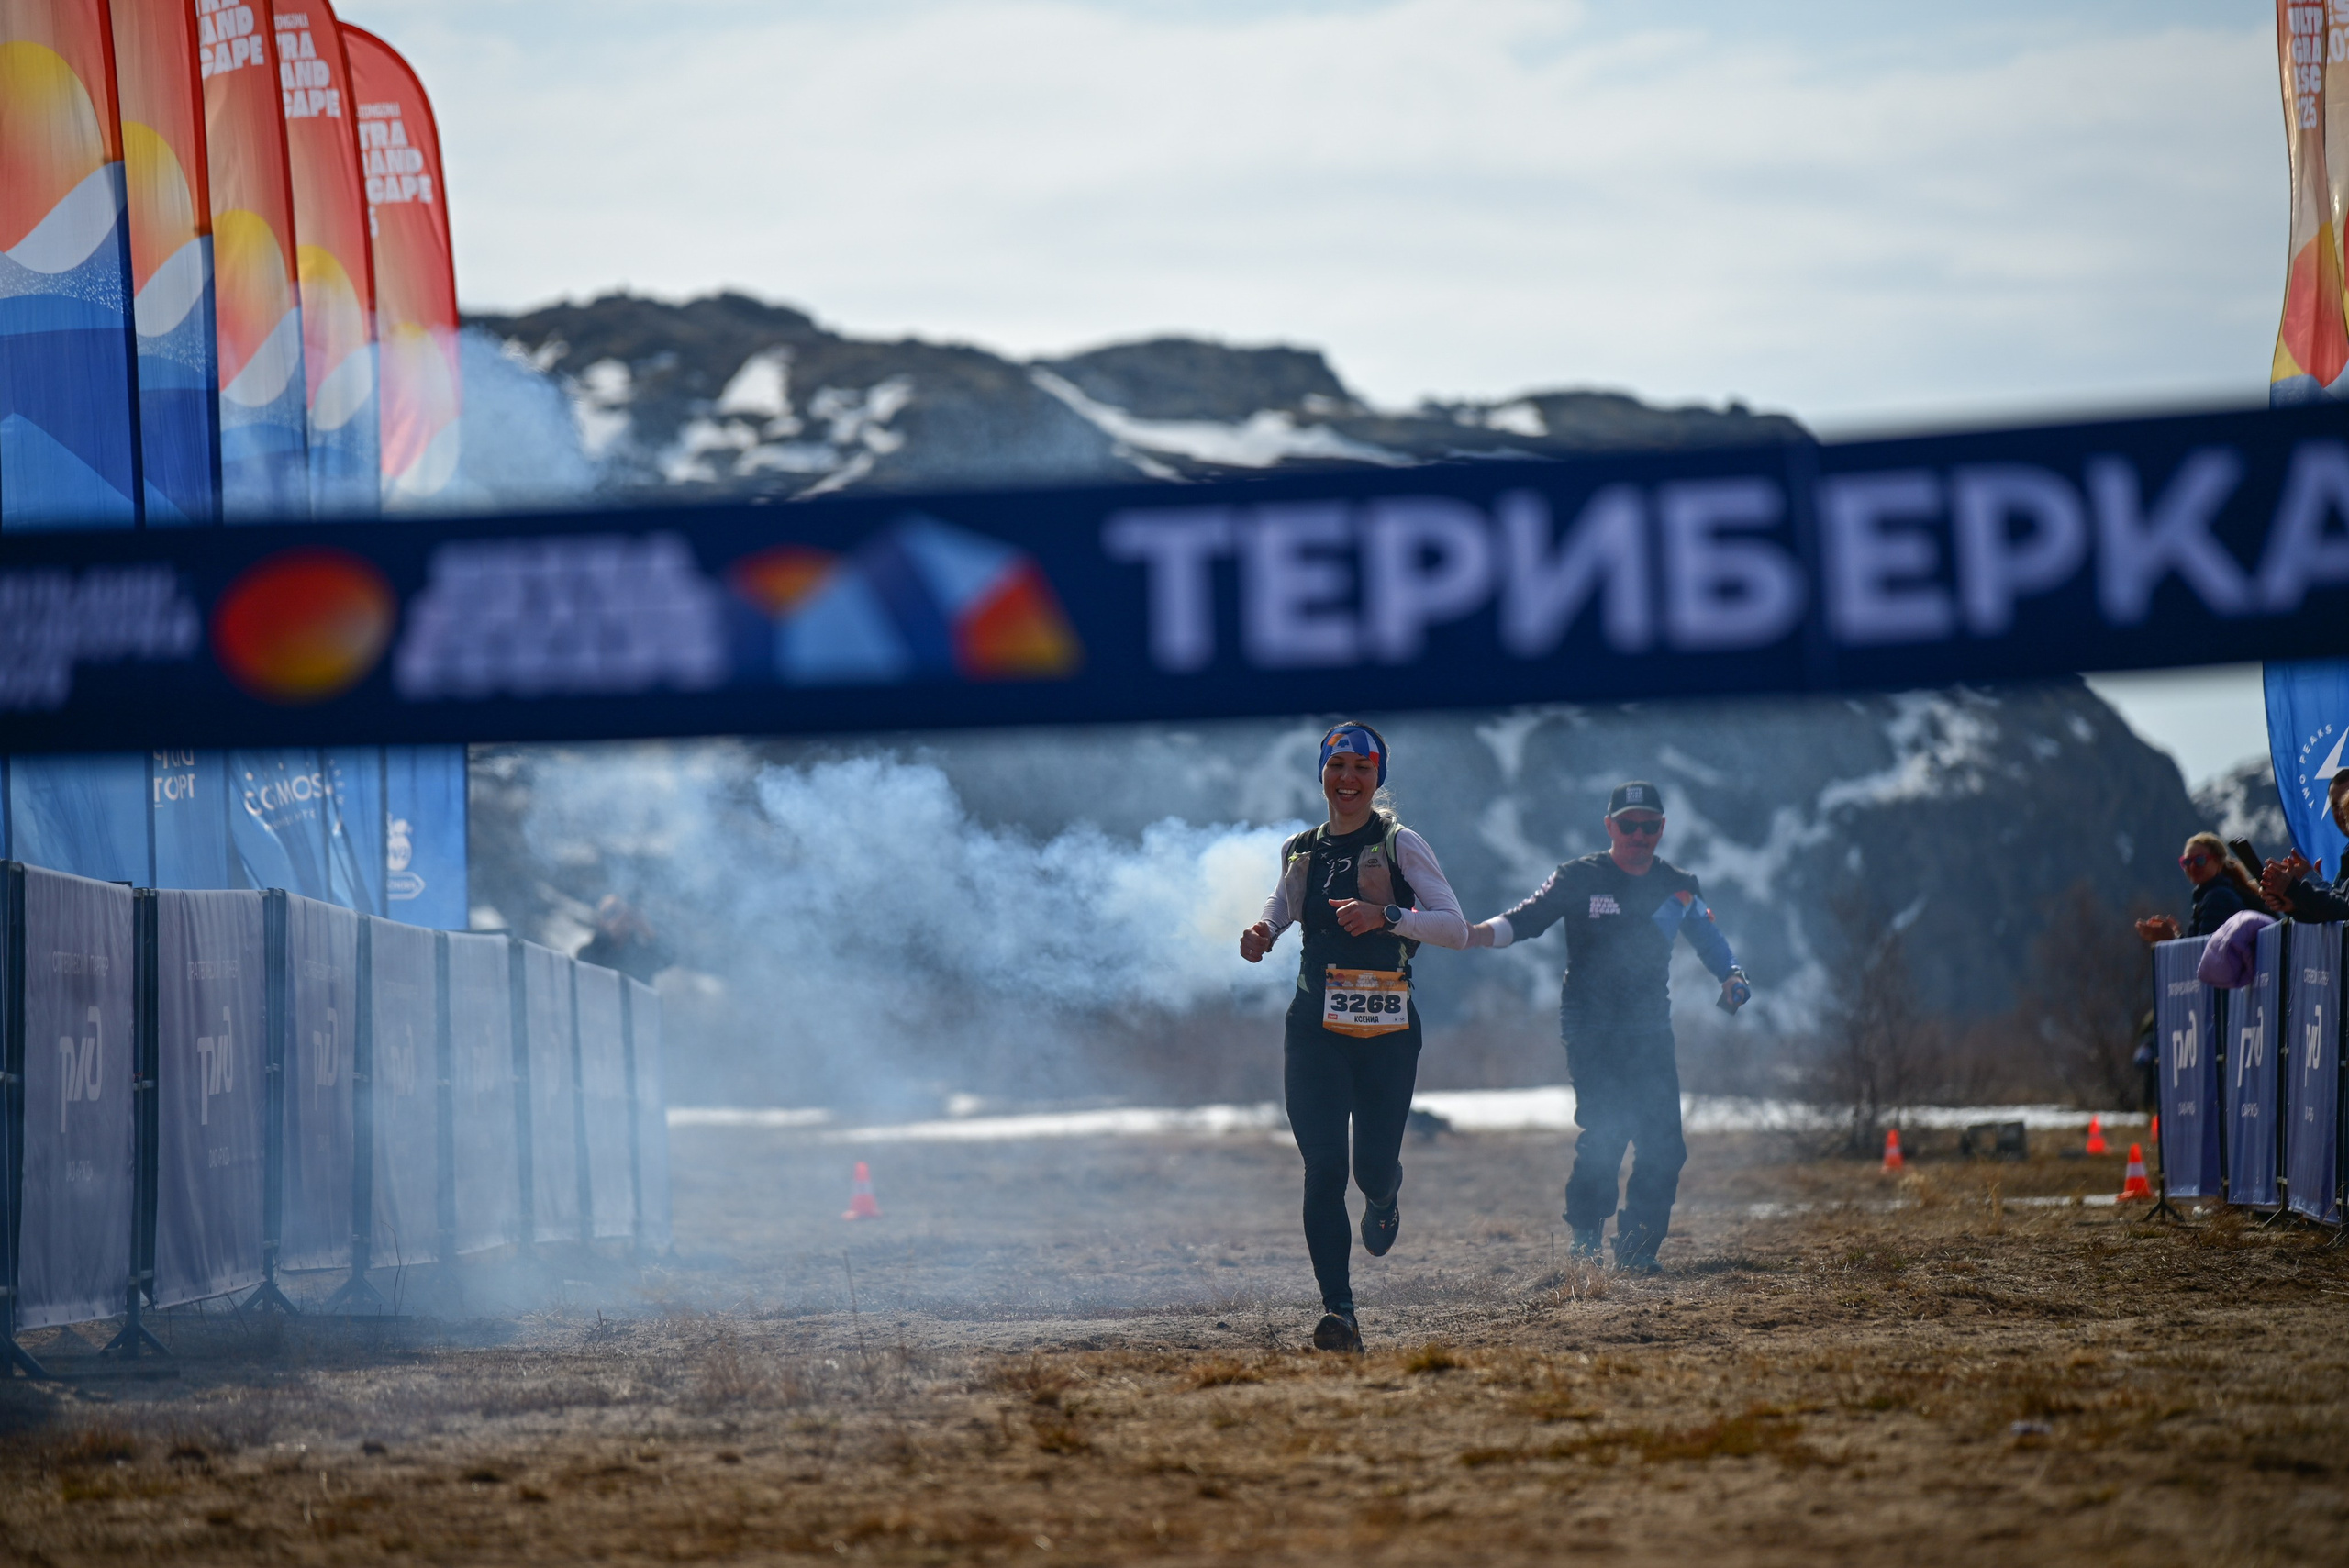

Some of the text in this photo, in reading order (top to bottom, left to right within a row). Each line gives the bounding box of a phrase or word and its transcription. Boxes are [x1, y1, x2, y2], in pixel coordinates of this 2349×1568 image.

[1103, 442, 2349, 673] ТЕРИБЕРКА
[2299, 724, 2332, 809] TWO PEAKS
[1330, 994, 1401, 1014] 3268
[1354, 1015, 1379, 1024] КСЕНИЯ
